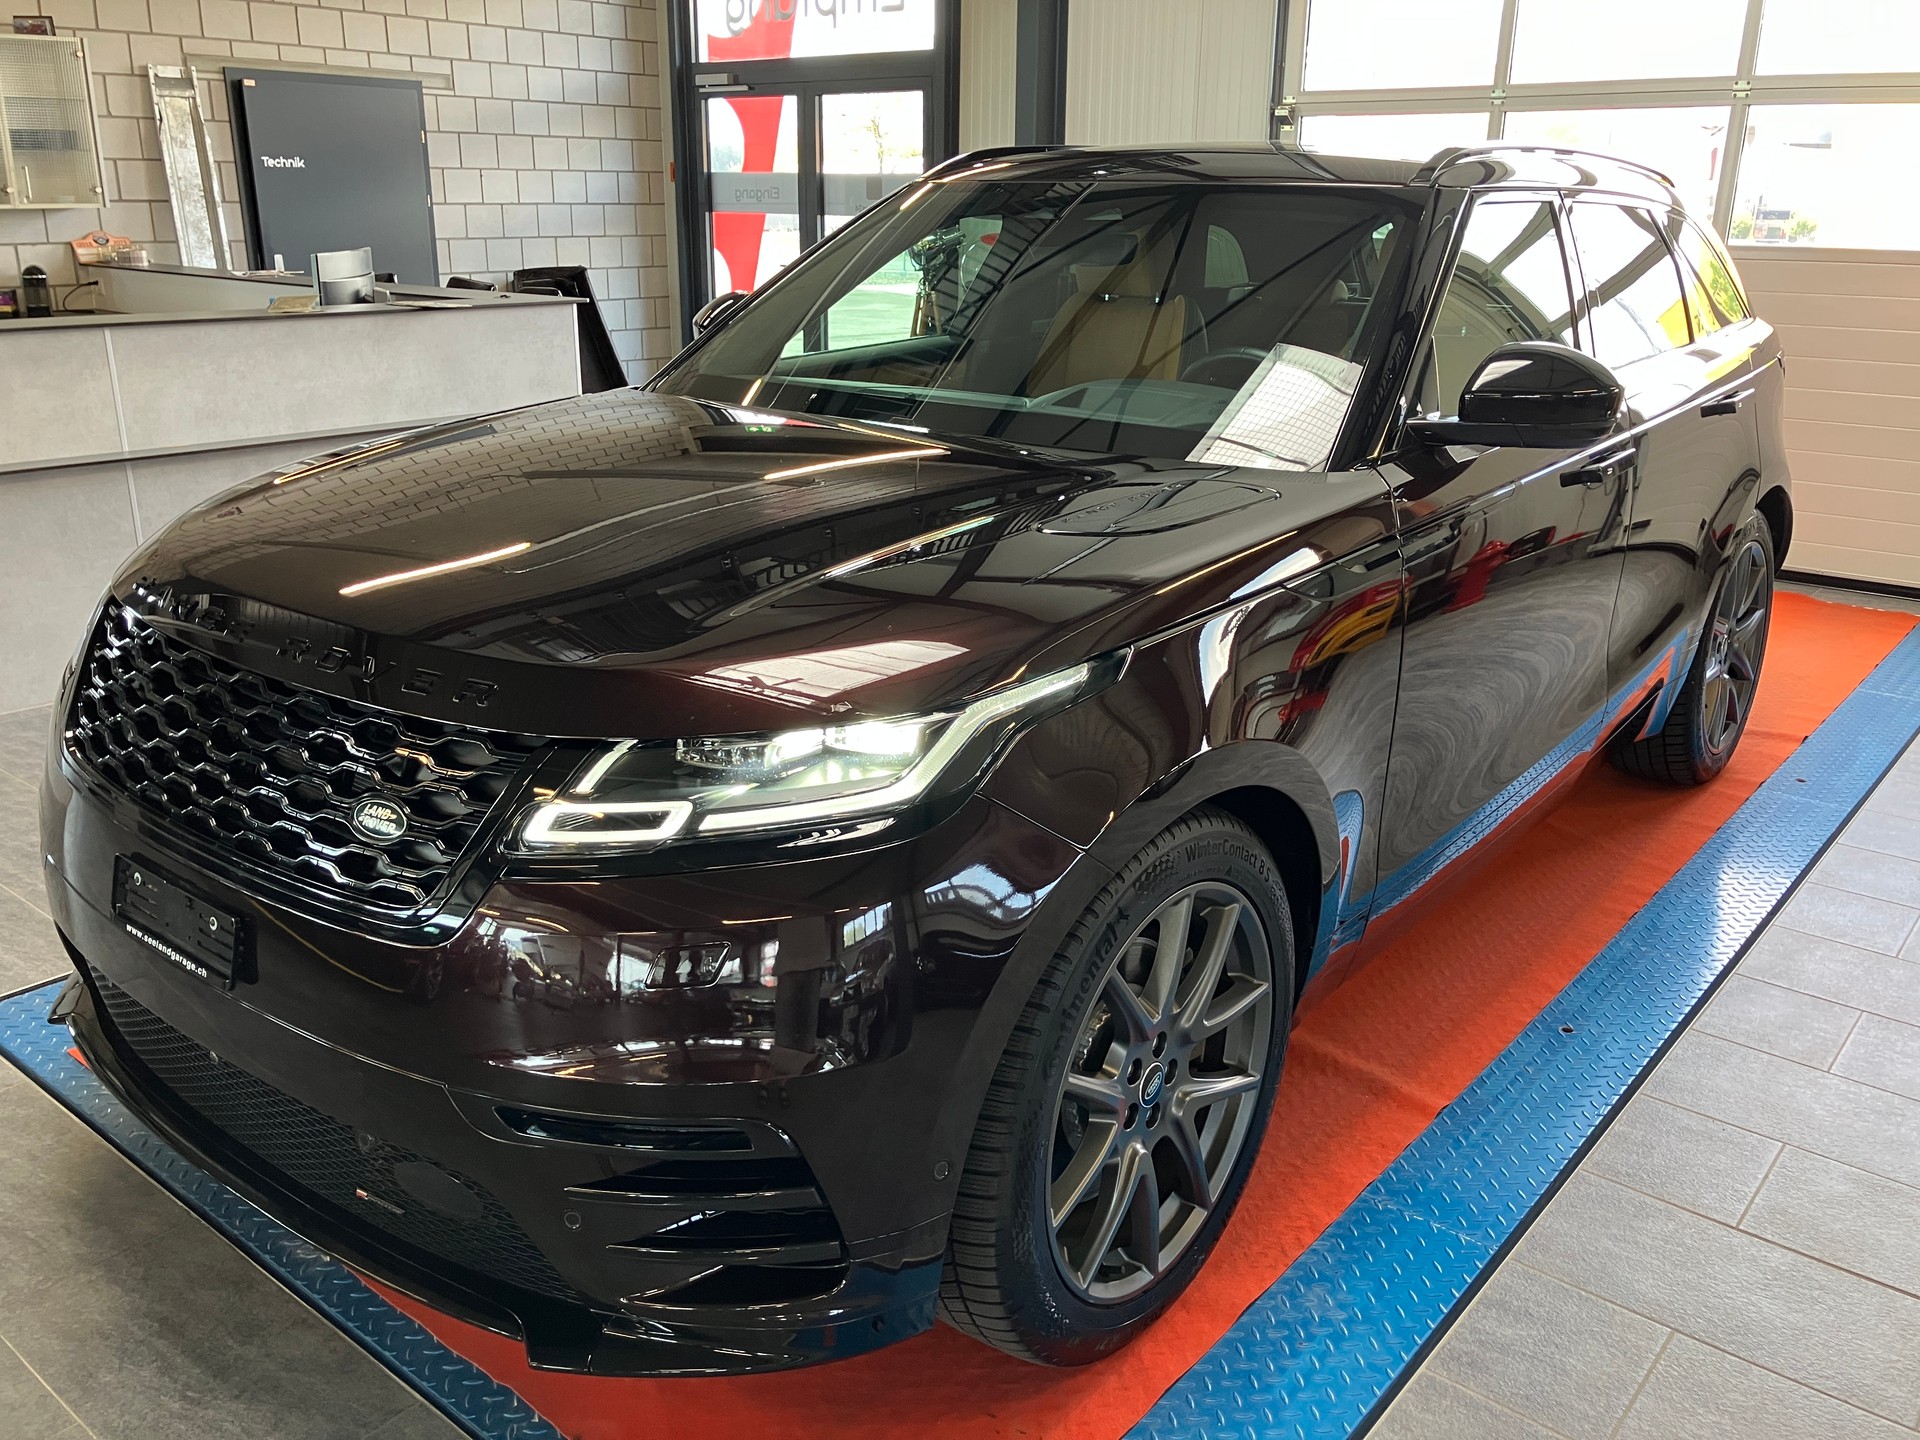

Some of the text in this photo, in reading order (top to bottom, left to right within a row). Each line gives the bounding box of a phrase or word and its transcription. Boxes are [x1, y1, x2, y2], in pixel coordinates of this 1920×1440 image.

[260, 156, 306, 169] Technik
[276, 637, 500, 708] ROVER
[361, 814, 397, 835] ROVER
[363, 803, 392, 821] LAND
[1184, 838, 1258, 869] WinterContact
[1258, 857, 1266, 875] 8
[126, 923, 208, 979] www.seelandgarage.ch
